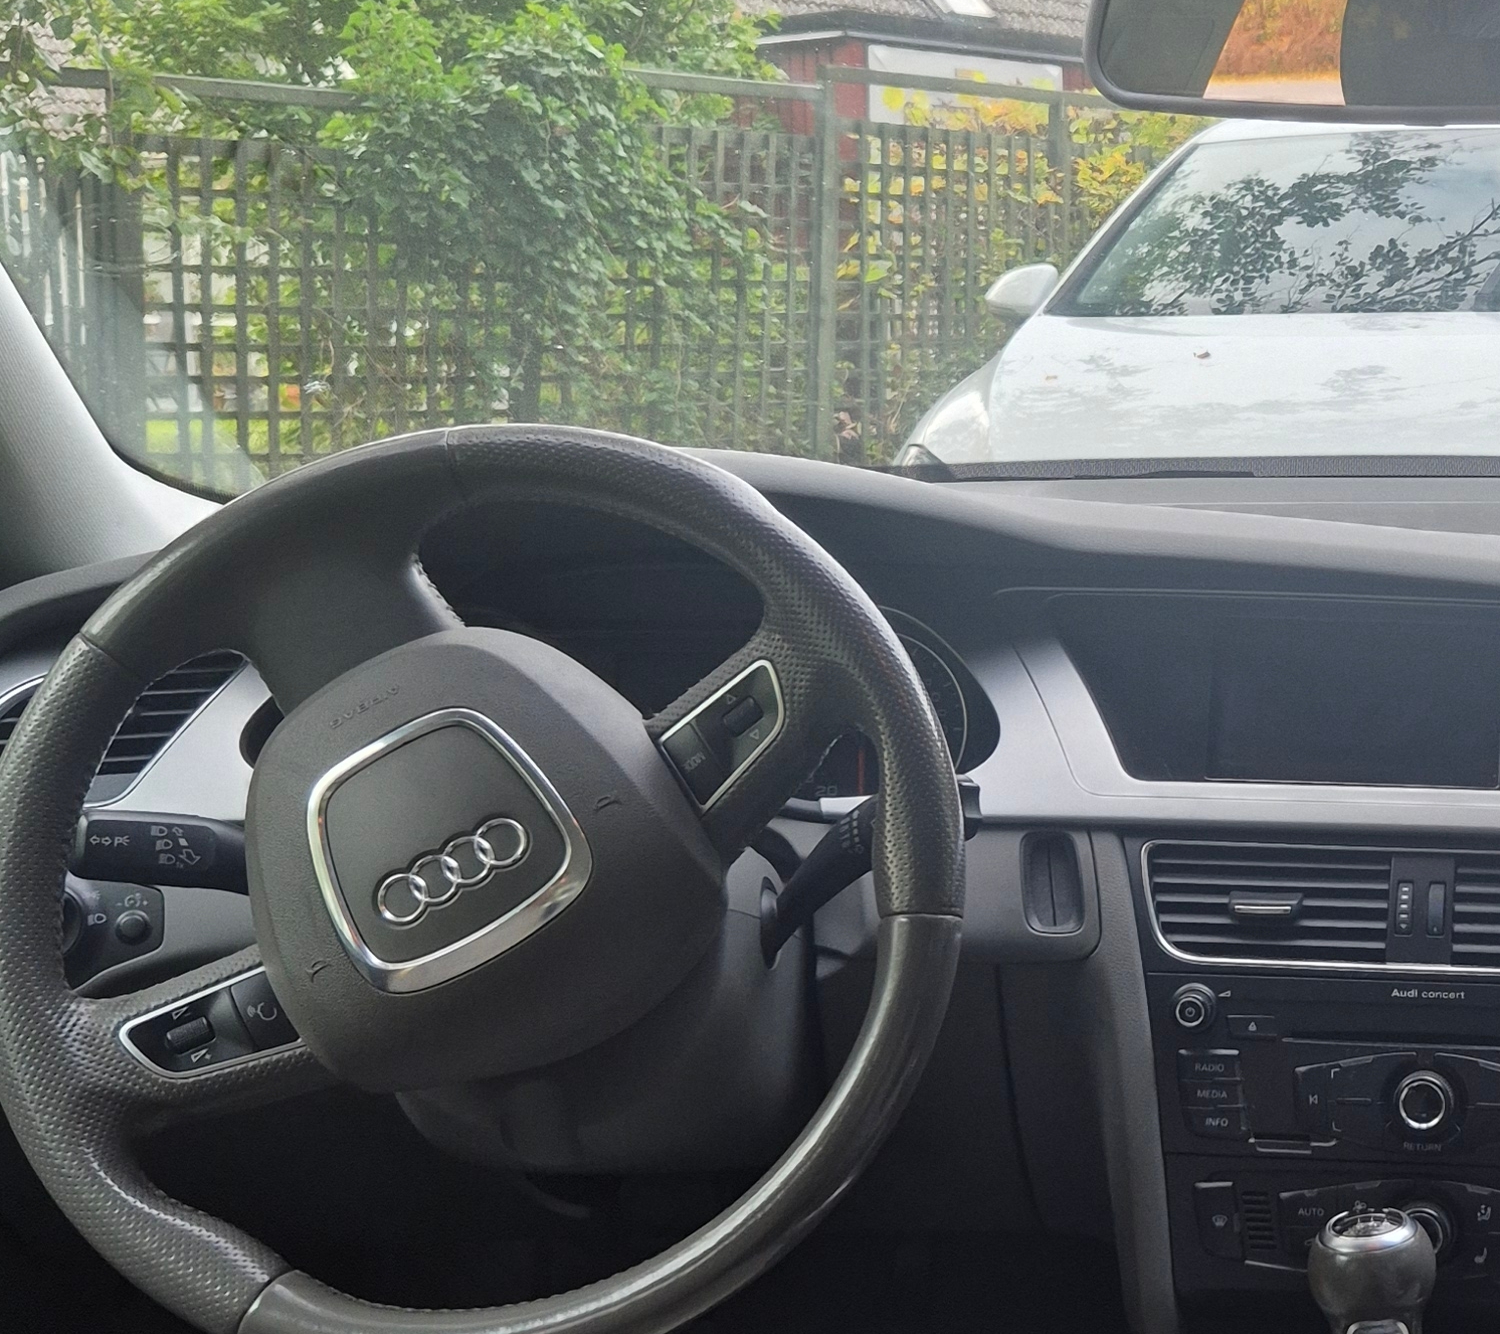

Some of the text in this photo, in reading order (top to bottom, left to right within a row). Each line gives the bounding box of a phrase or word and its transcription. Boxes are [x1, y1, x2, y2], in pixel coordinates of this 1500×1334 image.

[1391, 988, 1465, 1000] Audi concert
[1194, 1063, 1225, 1072] RADIO
[1196, 1089, 1227, 1098] MEDIA
[1205, 1117, 1229, 1127] INFO
[1403, 1141, 1442, 1152] RETURN
[1298, 1207, 1325, 1216] AUTO
